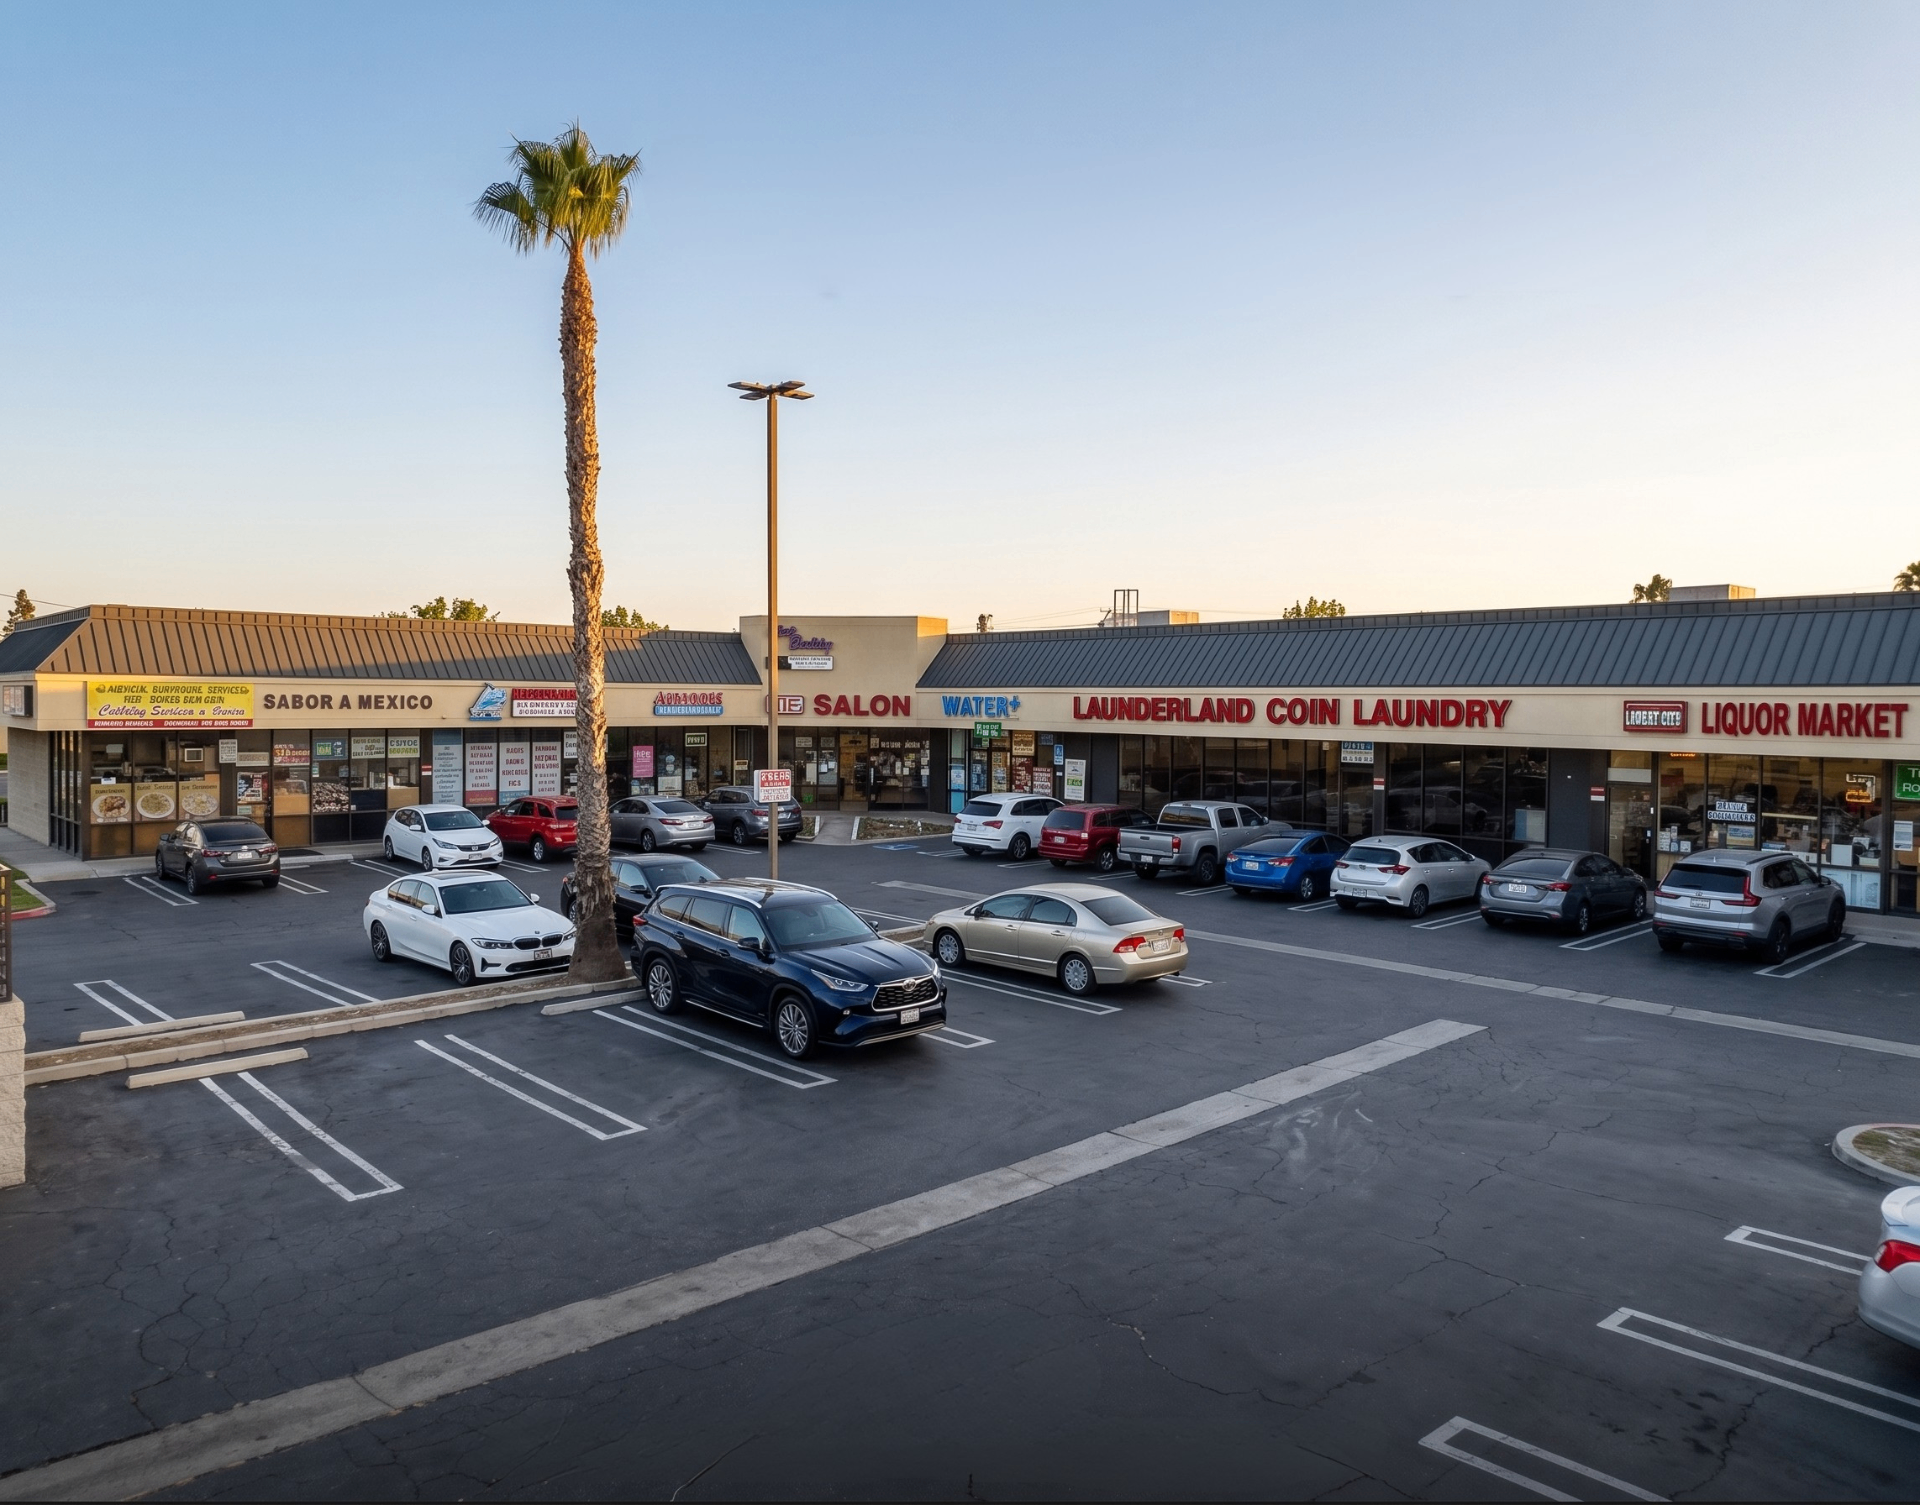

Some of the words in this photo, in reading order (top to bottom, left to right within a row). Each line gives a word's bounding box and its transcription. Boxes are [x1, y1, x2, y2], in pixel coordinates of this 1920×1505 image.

[264, 694, 334, 710] SABOR
[339, 695, 352, 710] A
[358, 694, 434, 710] MEXICO
[814, 694, 911, 717] SALON
[1073, 696, 1256, 724] LAUNDERLAND
[1266, 697, 1341, 726] COIN
[1353, 699, 1513, 728] LAUNDRY
[1702, 702, 1791, 737] LIQUOR
[1798, 703, 1909, 738] MARKET
